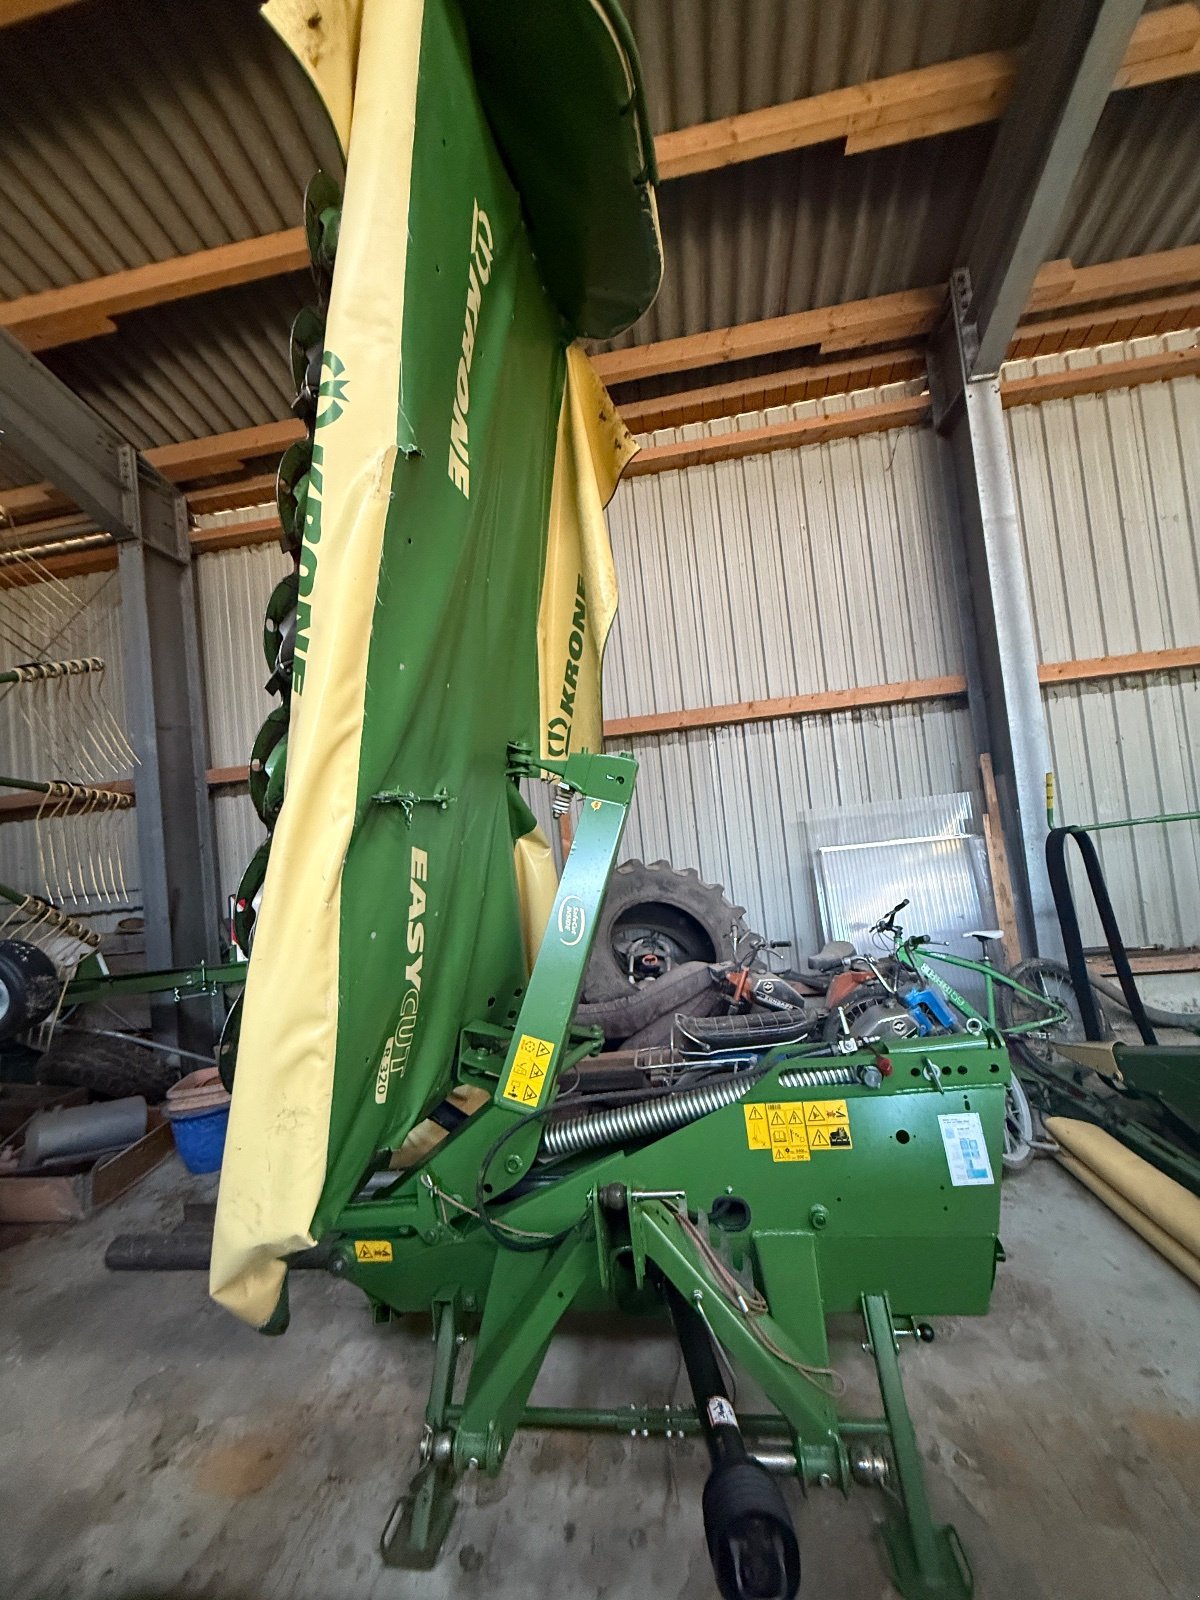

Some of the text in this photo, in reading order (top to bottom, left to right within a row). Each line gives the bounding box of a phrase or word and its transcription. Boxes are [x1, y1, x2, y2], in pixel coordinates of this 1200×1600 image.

[447, 261, 482, 500] KRONE
[559, 573, 587, 719] KRONE
[377, 1047, 391, 1095] R 320
